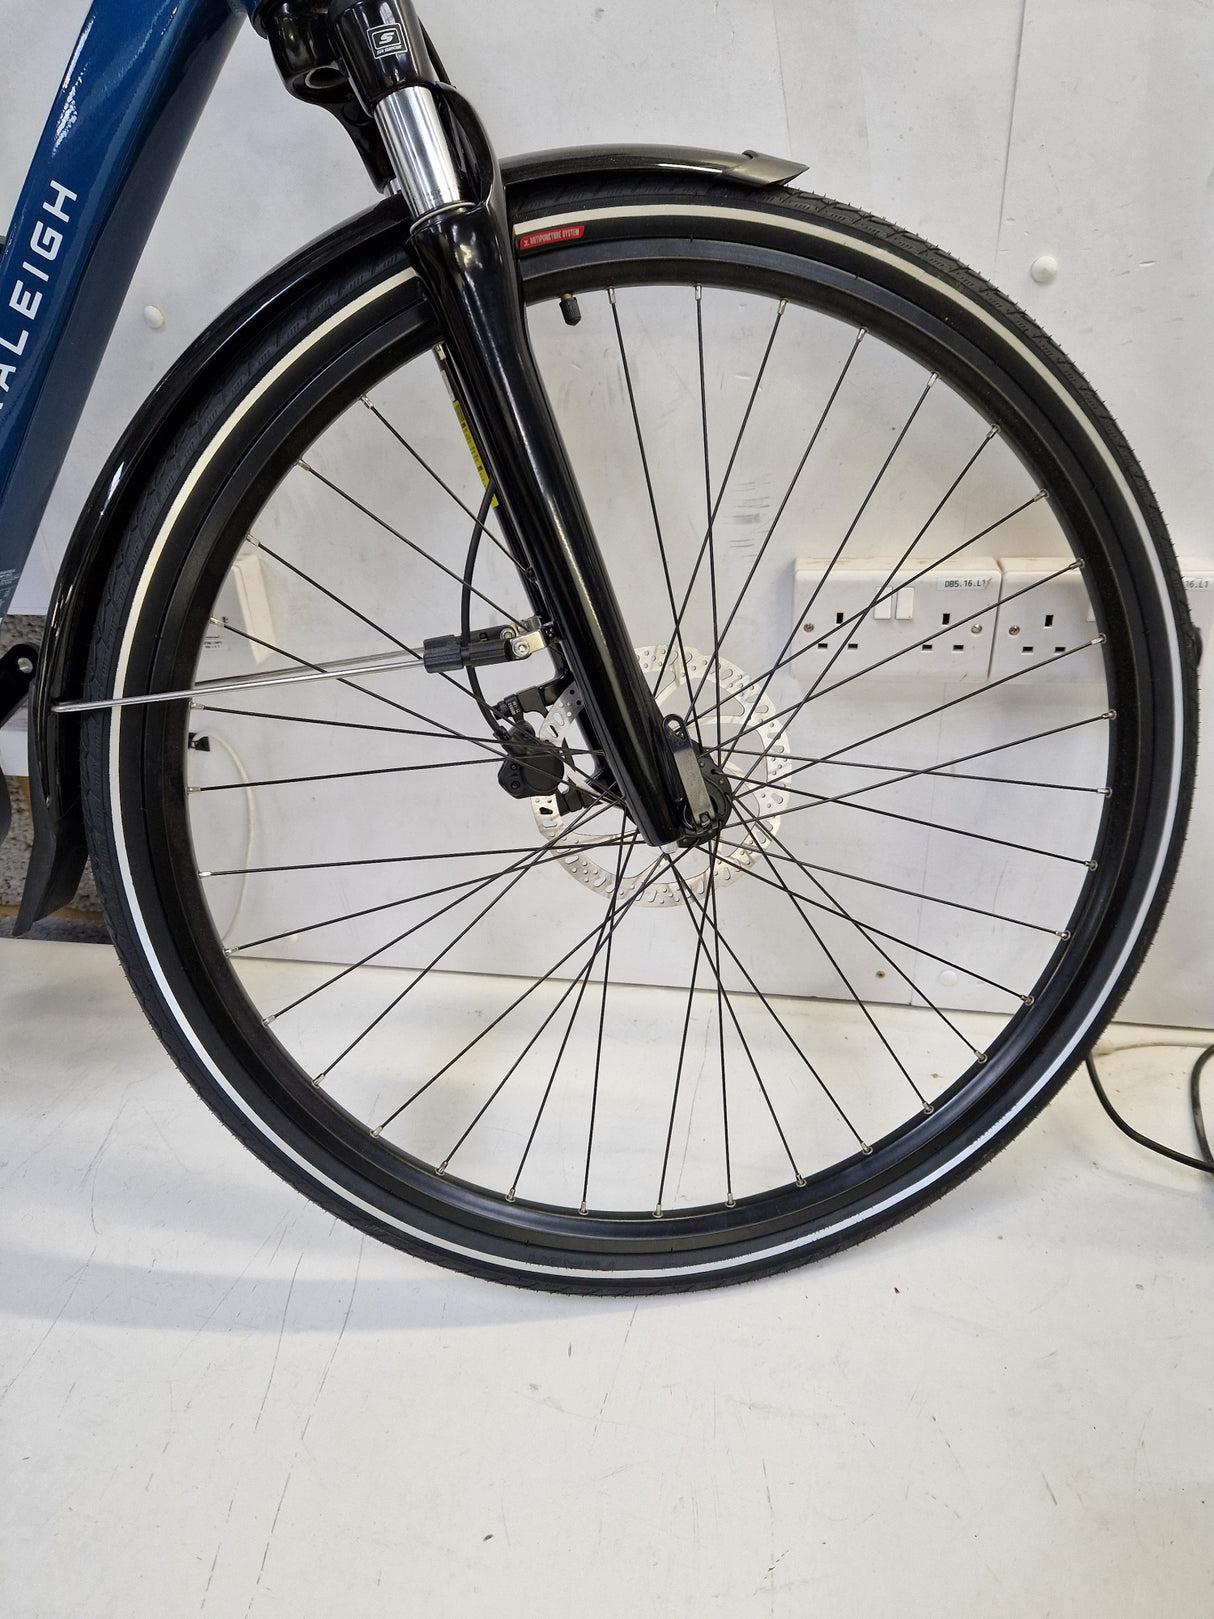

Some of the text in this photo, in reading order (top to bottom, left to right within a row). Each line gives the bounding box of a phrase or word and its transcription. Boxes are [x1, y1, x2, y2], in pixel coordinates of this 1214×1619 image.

[530, 230, 562, 245] ANTIPUNCTURE
[562, 228, 580, 238] SYSTEM
[0, 179, 78, 409] ALEIGH
[1184, 580, 1209, 589] 16.L1
